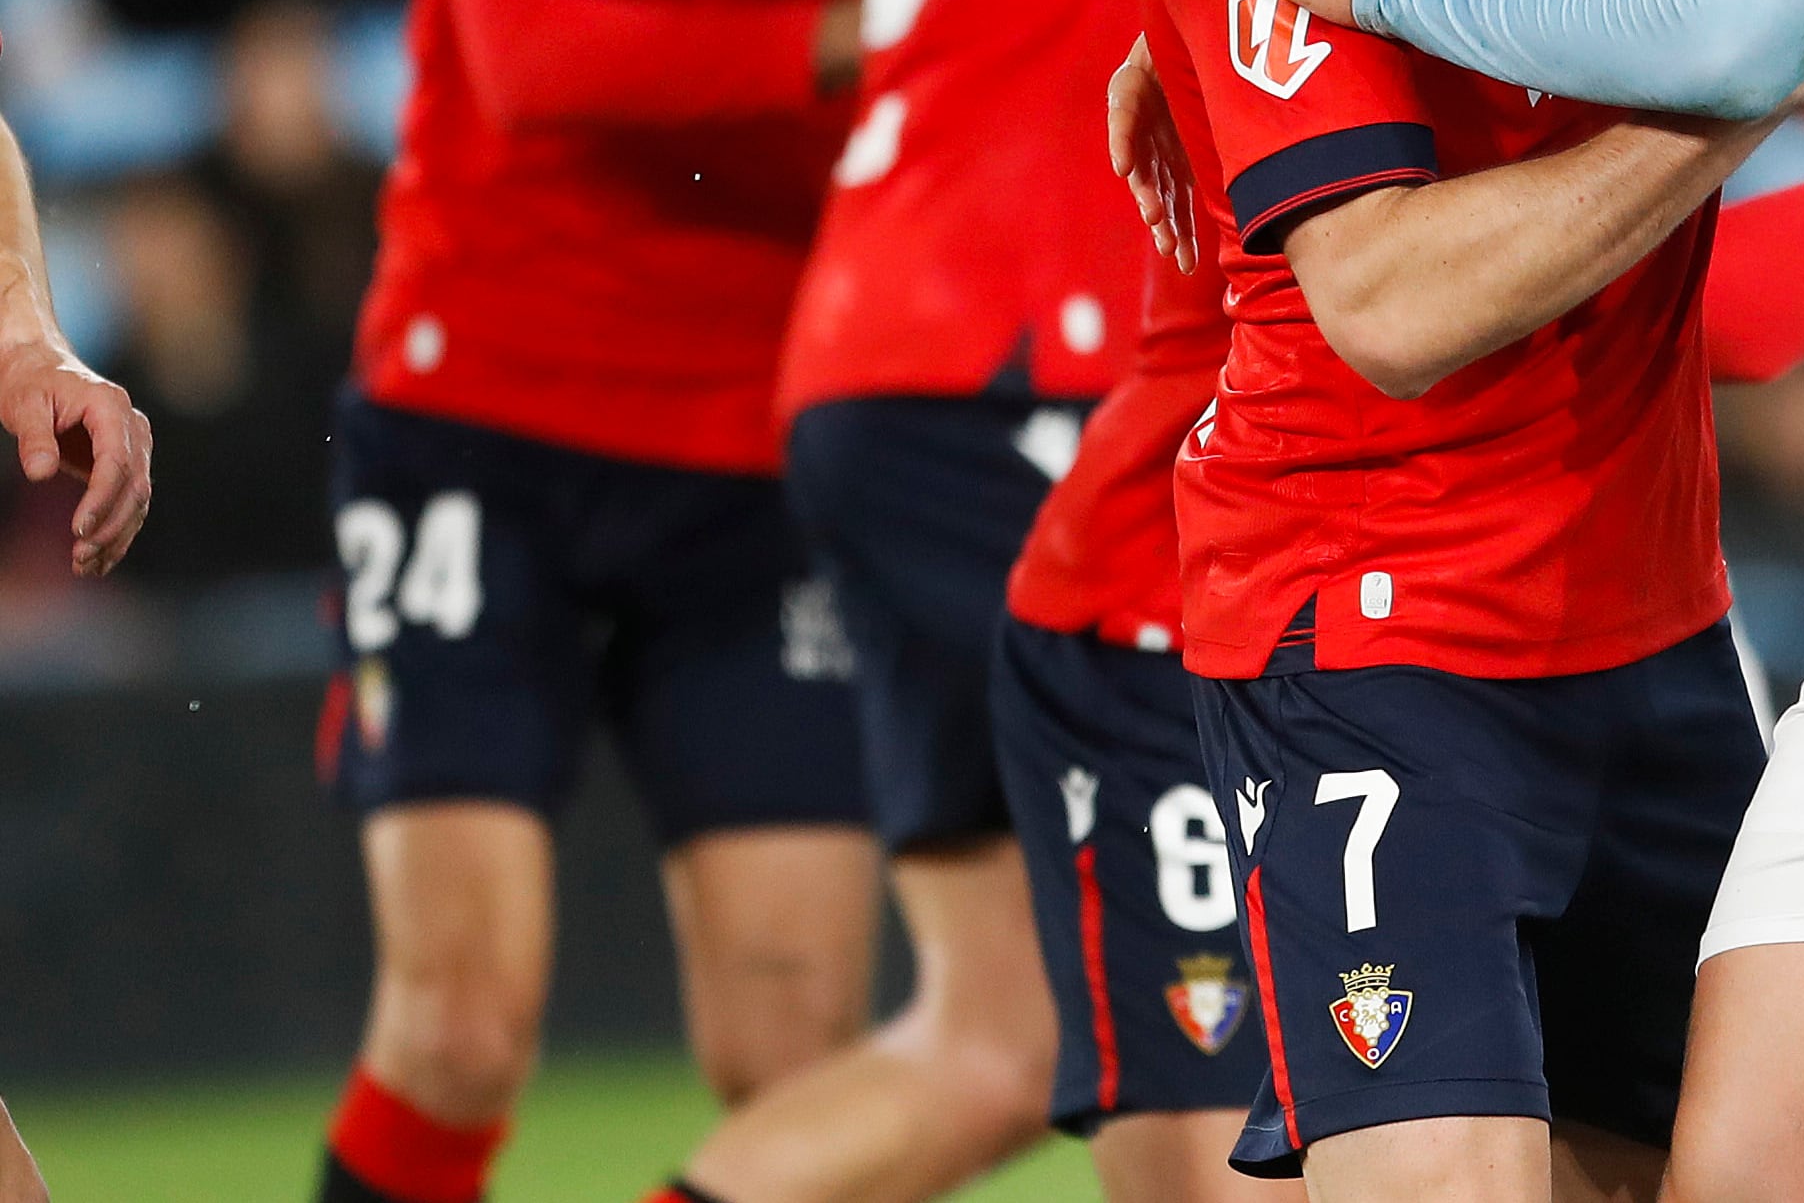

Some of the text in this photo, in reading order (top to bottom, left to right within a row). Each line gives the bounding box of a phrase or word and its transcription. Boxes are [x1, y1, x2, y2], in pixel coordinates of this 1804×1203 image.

[335, 489, 485, 652] 24
[1149, 782, 1237, 932] 6
[1314, 769, 1400, 934] 7
